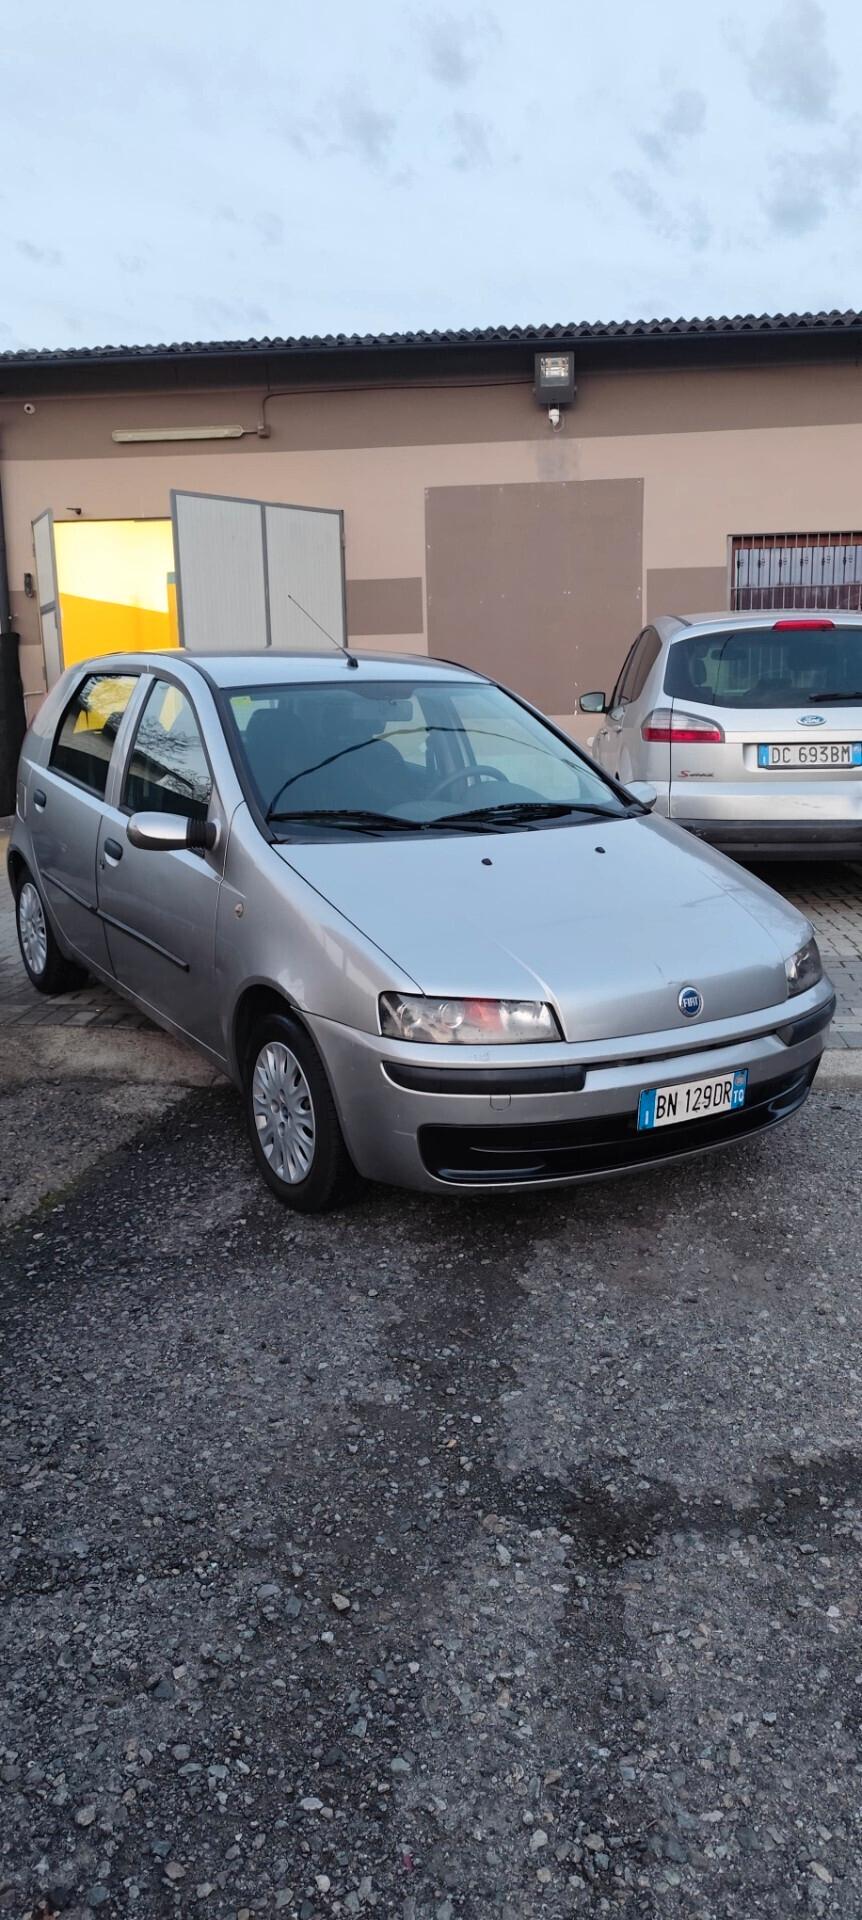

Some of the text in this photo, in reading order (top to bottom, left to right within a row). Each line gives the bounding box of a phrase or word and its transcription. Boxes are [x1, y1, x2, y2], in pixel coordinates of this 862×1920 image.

[771, 747, 791, 764] DC
[798, 745, 850, 763] 693BM
[682, 996, 699, 1008] FIAT
[656, 1091, 678, 1120] BN
[685, 1080, 732, 1113] 129DR
[733, 1089, 745, 1104] TO
